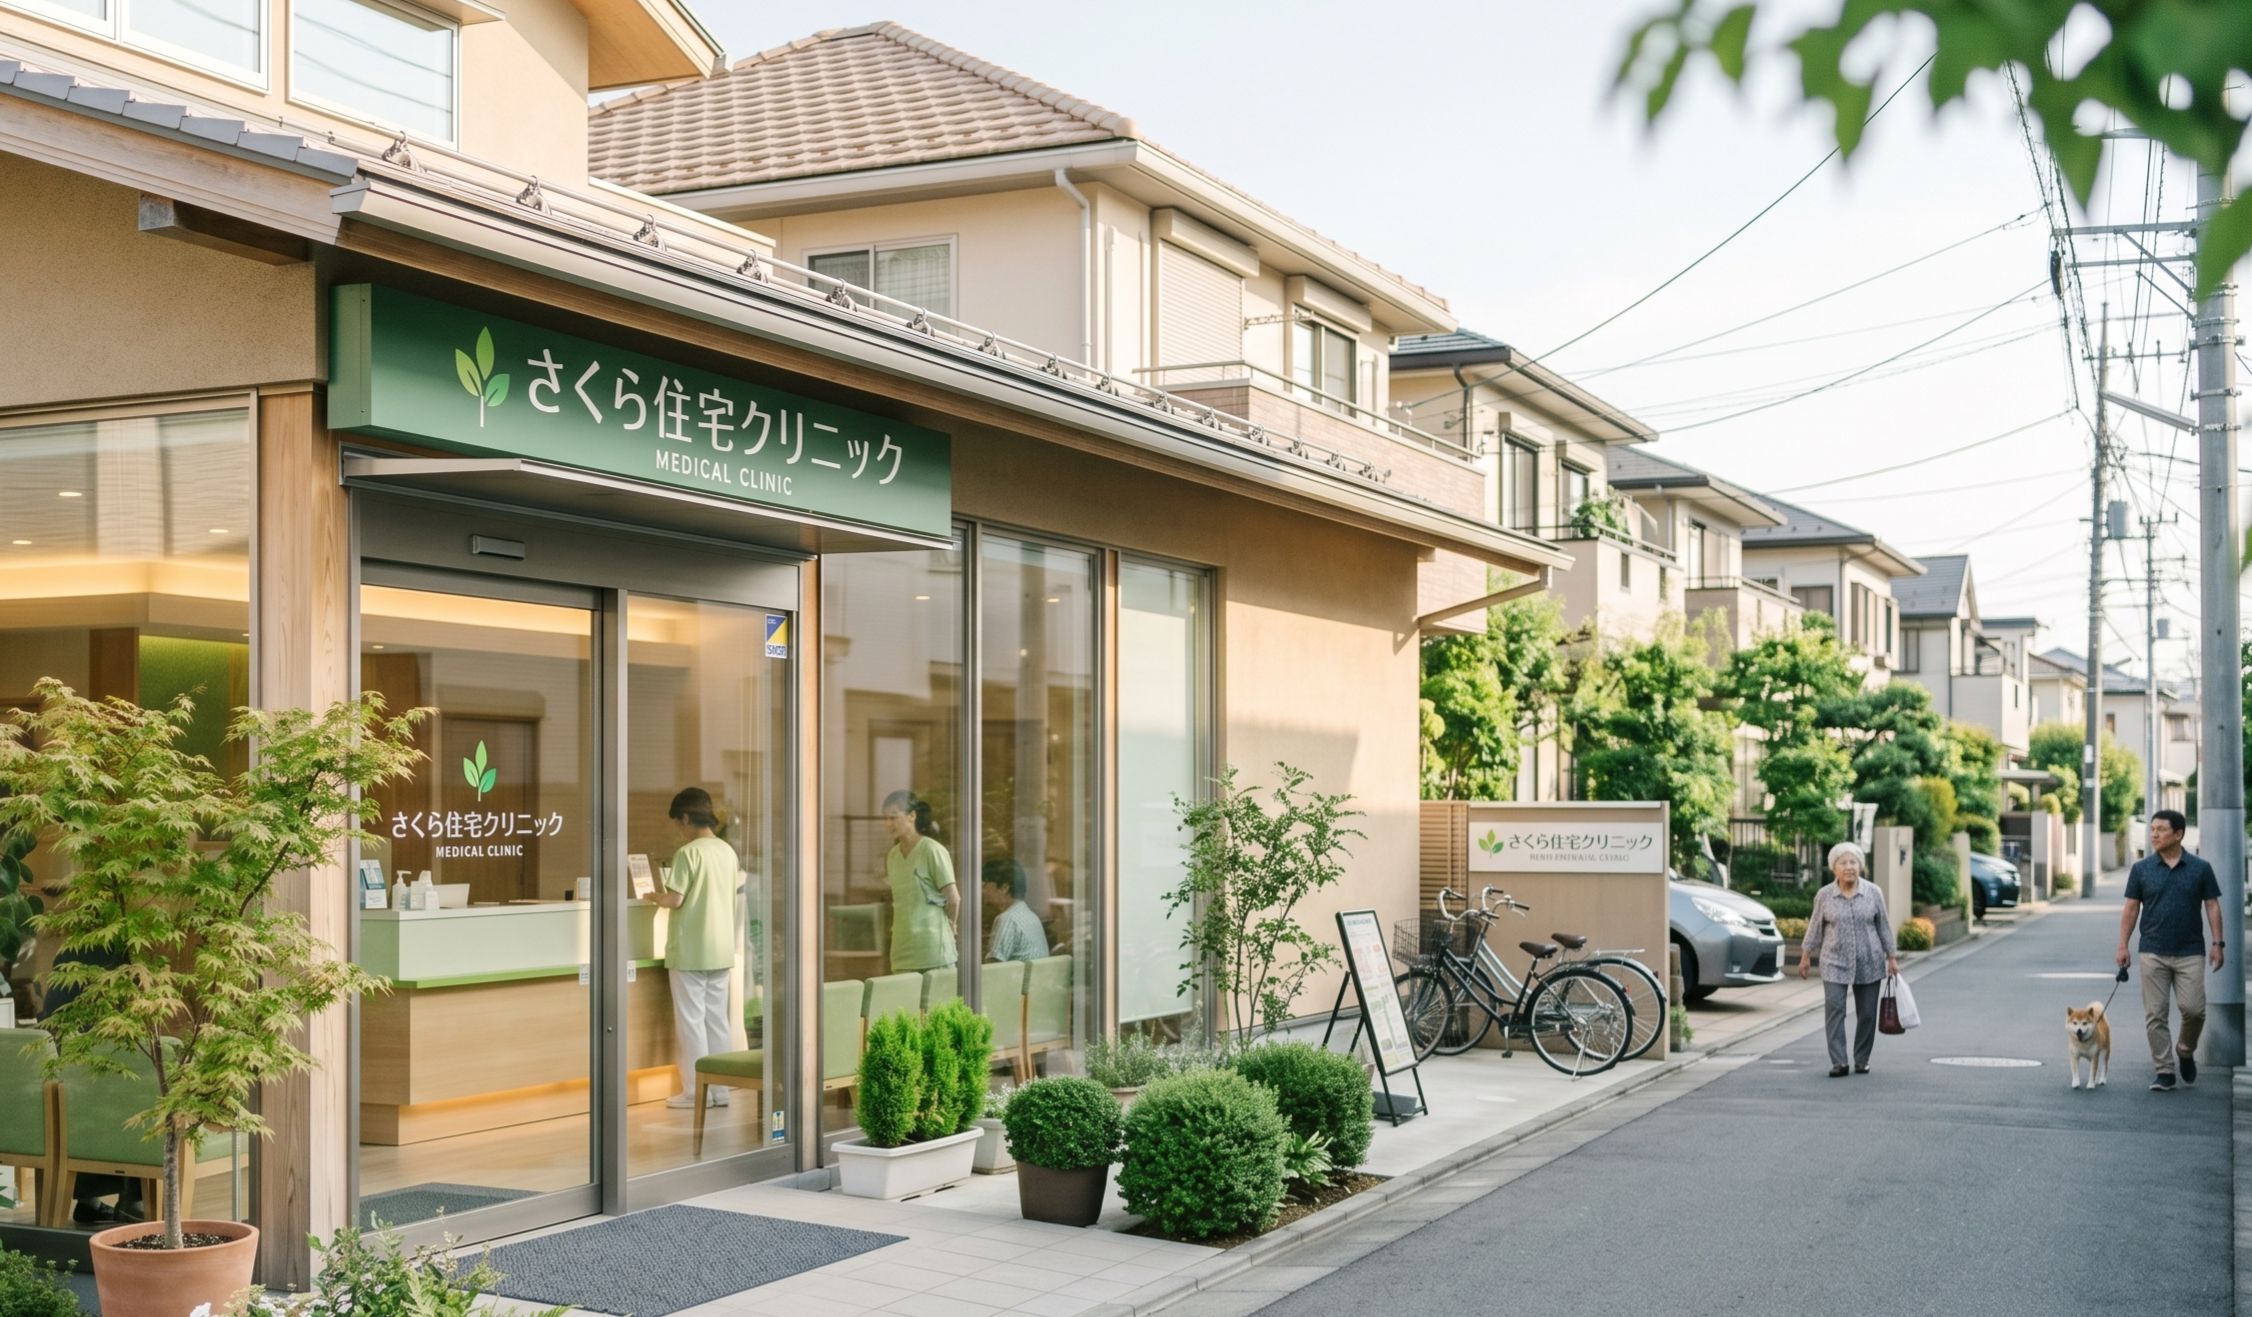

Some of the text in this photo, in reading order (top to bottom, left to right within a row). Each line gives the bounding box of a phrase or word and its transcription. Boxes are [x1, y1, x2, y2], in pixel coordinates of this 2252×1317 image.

[527, 348, 903, 486] さくら住宅クリニック
[656, 449, 793, 496] MEDICAL CLINIC
[391, 811, 563, 838] さくら住宅クリニック
[435, 845, 523, 858] MEDICAL CLINIC
[1508, 833, 1653, 850] さくら住宅クリニック
